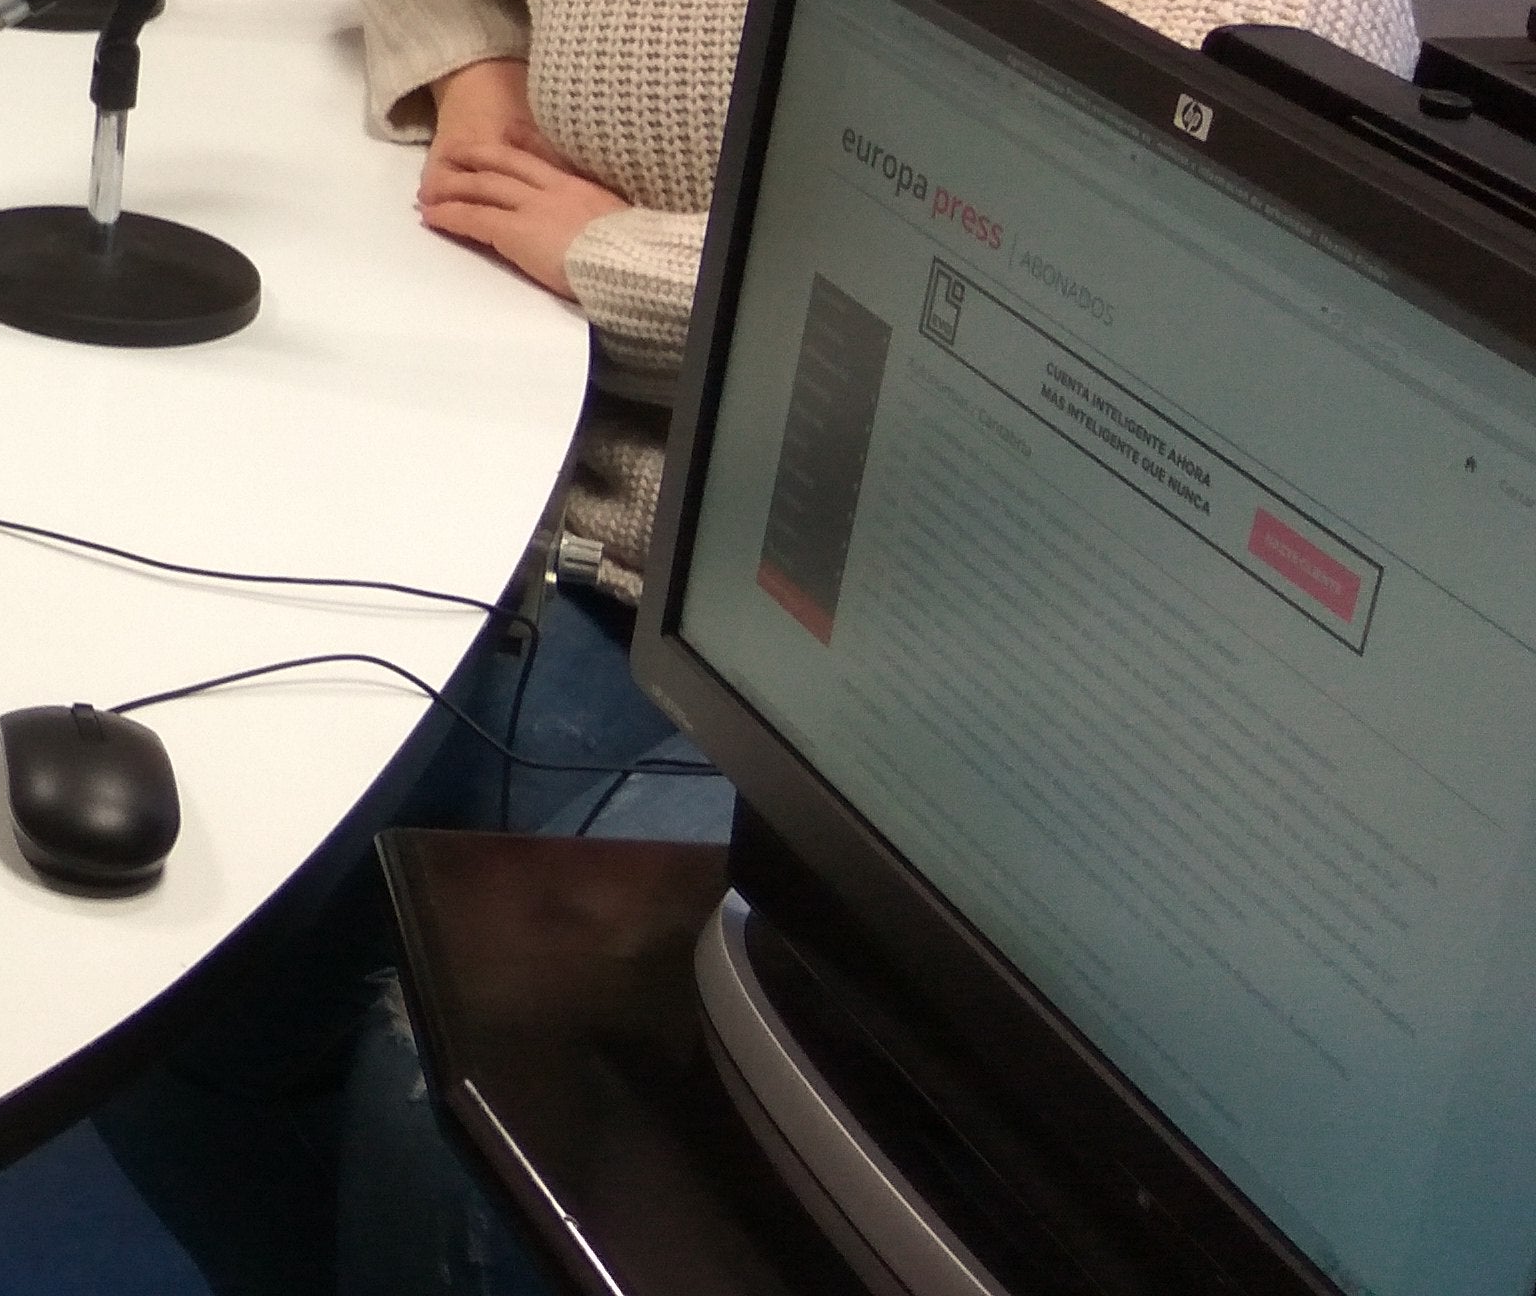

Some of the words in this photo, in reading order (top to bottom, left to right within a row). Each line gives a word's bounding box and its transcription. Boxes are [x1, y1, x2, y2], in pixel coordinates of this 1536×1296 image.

[842, 127, 928, 201] europa
[932, 185, 1004, 249] press
[1020, 251, 1115, 327] ABONADOS
[1046, 361, 1089, 401] CUENTA
[1092, 393, 1167, 455] INTELIGENTE
[1167, 448, 1211, 487] AHORA
[1067, 403, 1140, 464] INTELIGENTE
[1141, 457, 1166, 483] QUE
[1167, 475, 1211, 515] NUNCA
